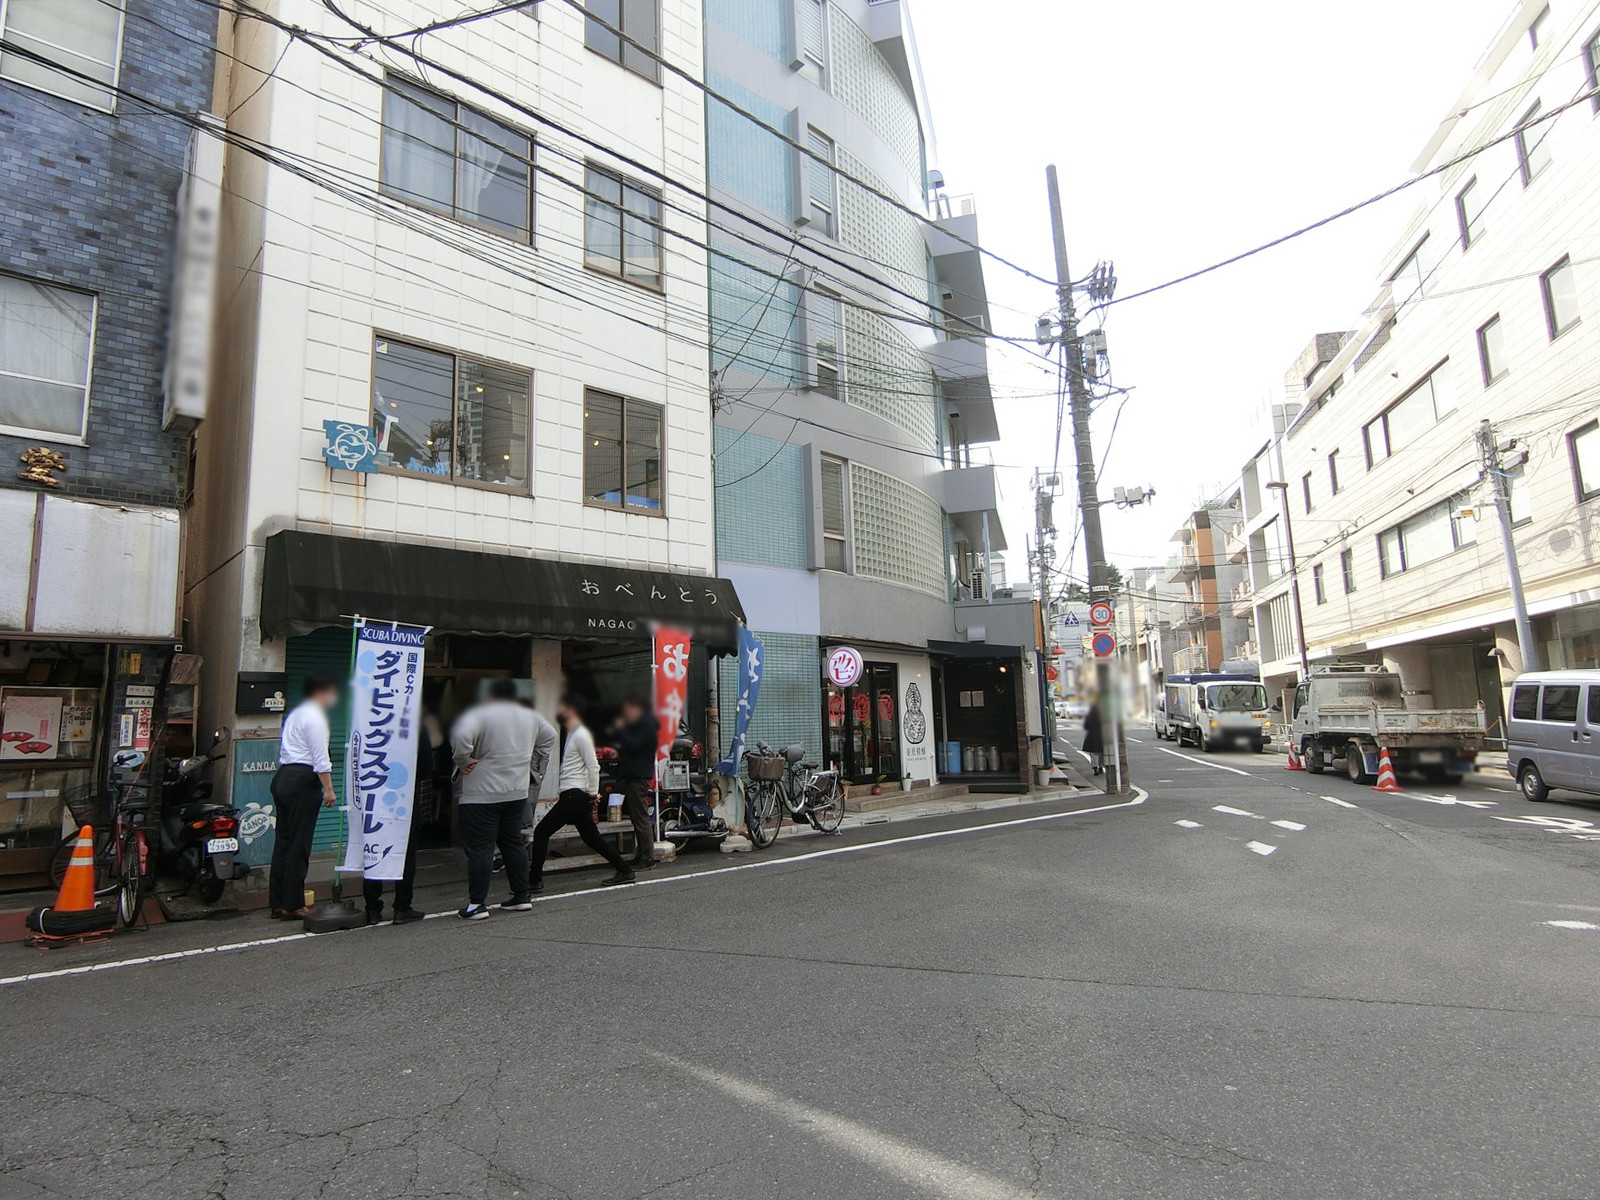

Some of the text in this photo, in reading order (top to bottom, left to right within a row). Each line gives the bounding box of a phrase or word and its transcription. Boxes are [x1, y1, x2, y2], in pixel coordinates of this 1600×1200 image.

[581, 578, 720, 605] おべんとう
[1095, 609, 1108, 620] 30
[361, 627, 425, 646] SCUBA DIVING
[360, 649, 403, 835] ダイビングスクール
[241, 816, 268, 832] KANOA
[363, 843, 379, 854] AC
